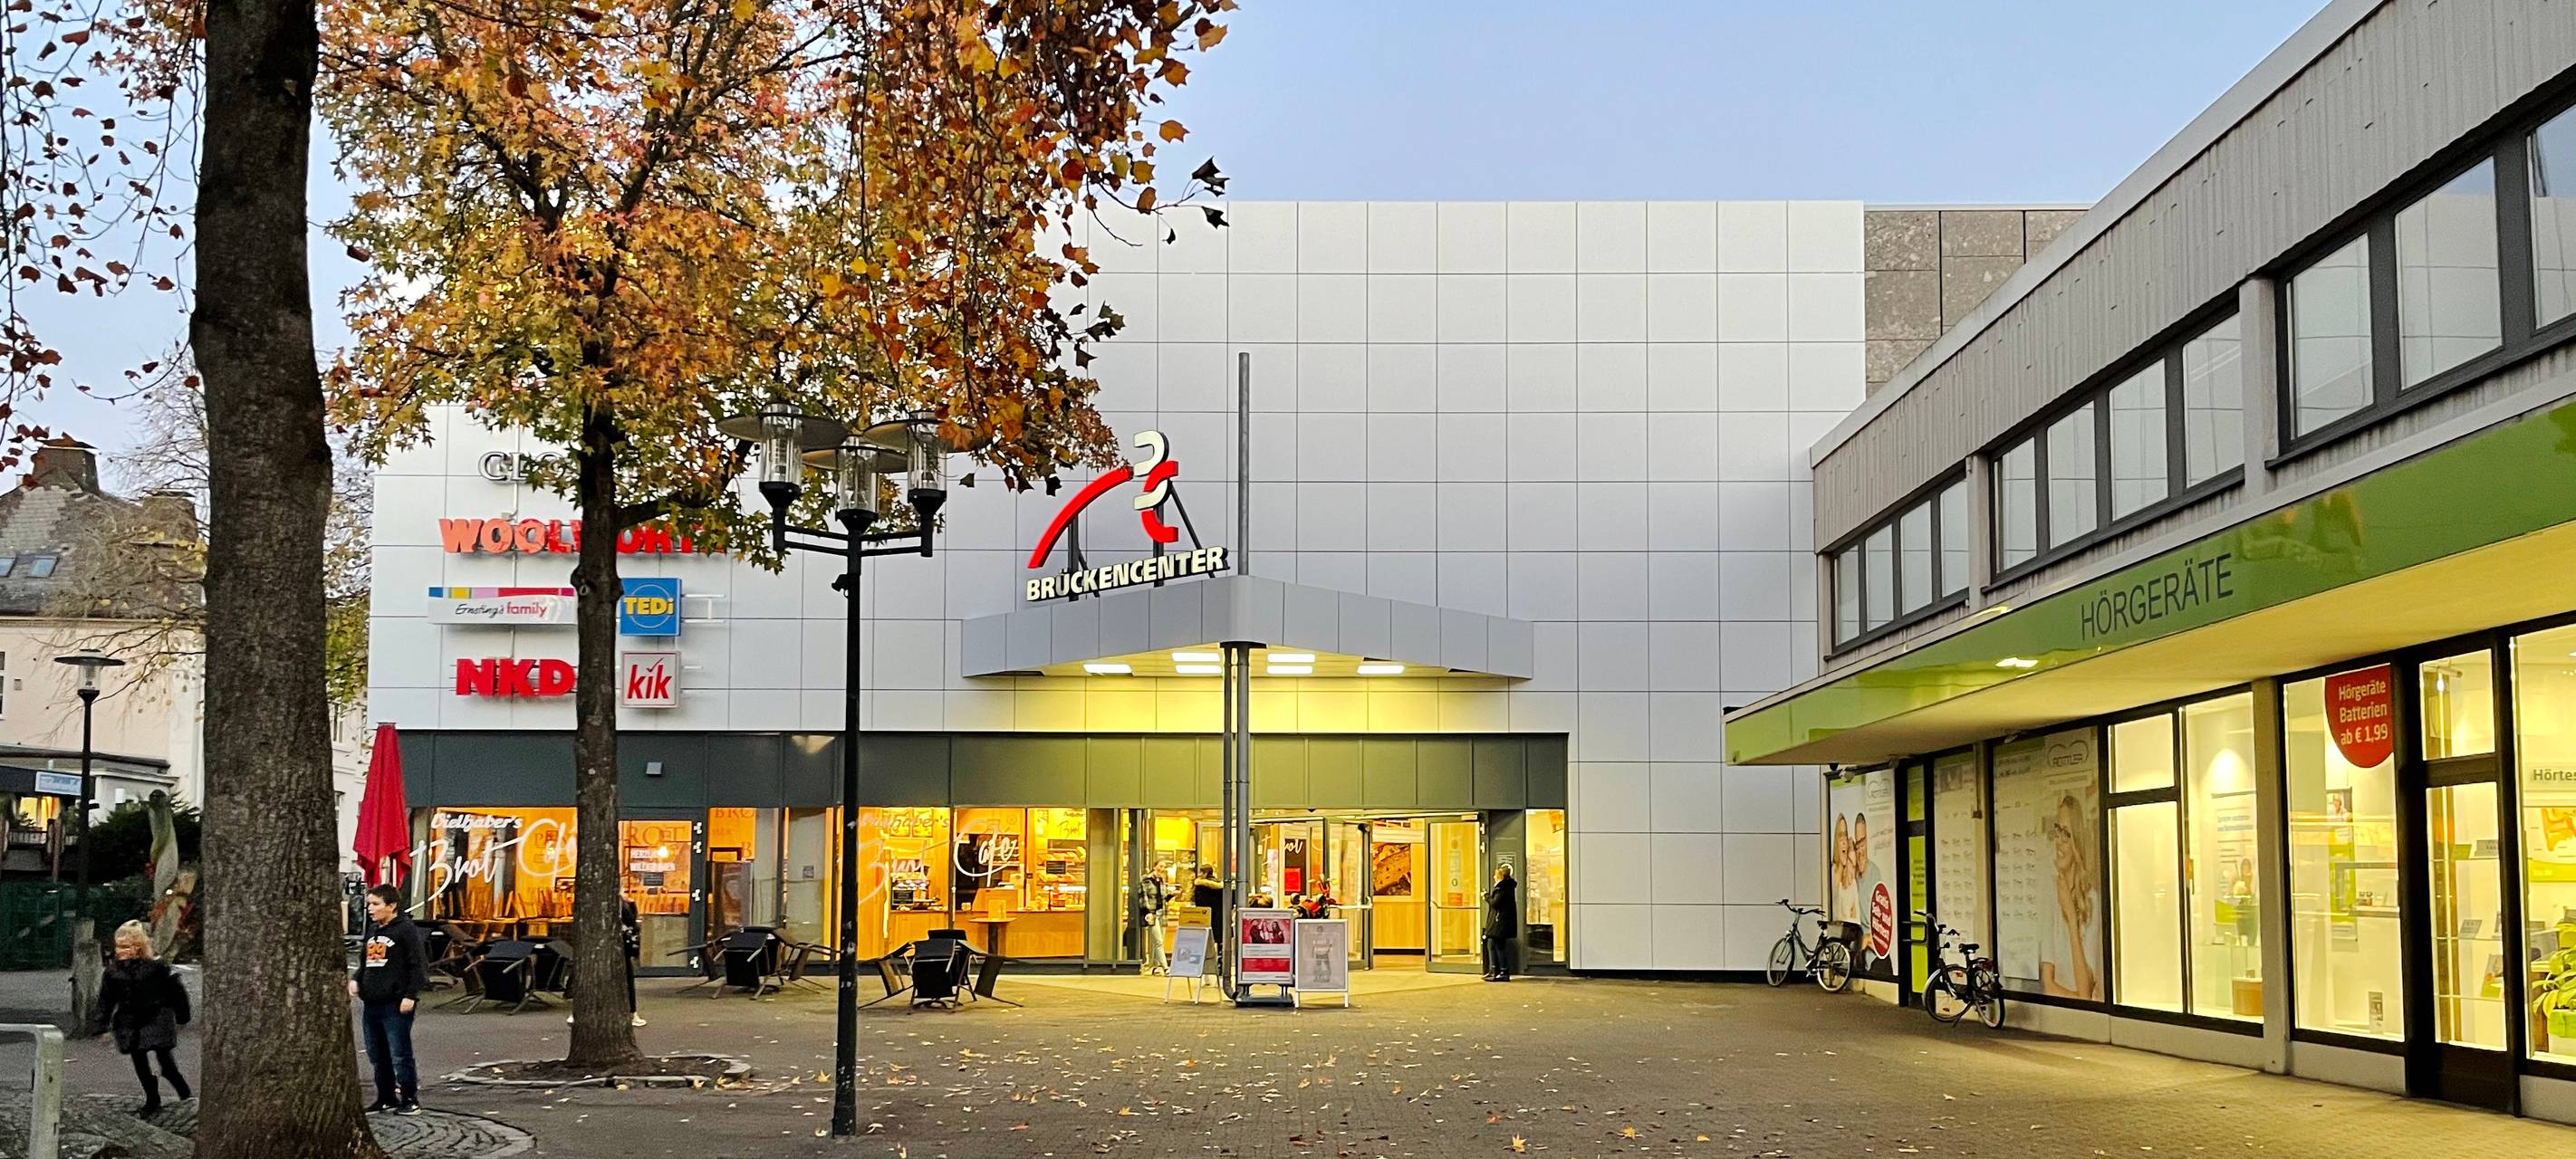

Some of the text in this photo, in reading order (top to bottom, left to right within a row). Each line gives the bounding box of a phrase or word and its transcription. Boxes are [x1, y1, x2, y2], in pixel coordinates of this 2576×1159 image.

[1026, 546, 1228, 601] BRÜCKENCENTER
[623, 597, 674, 616] TEDi
[2081, 553, 2234, 641] HÖRGERÄTE
[506, 601, 547, 618] family
[456, 658, 578, 696] NKD
[2339, 679, 2387, 702] Hörgeräte
[2340, 702, 2388, 723] Batterien
[2341, 723, 2388, 745] ab € 1,99
